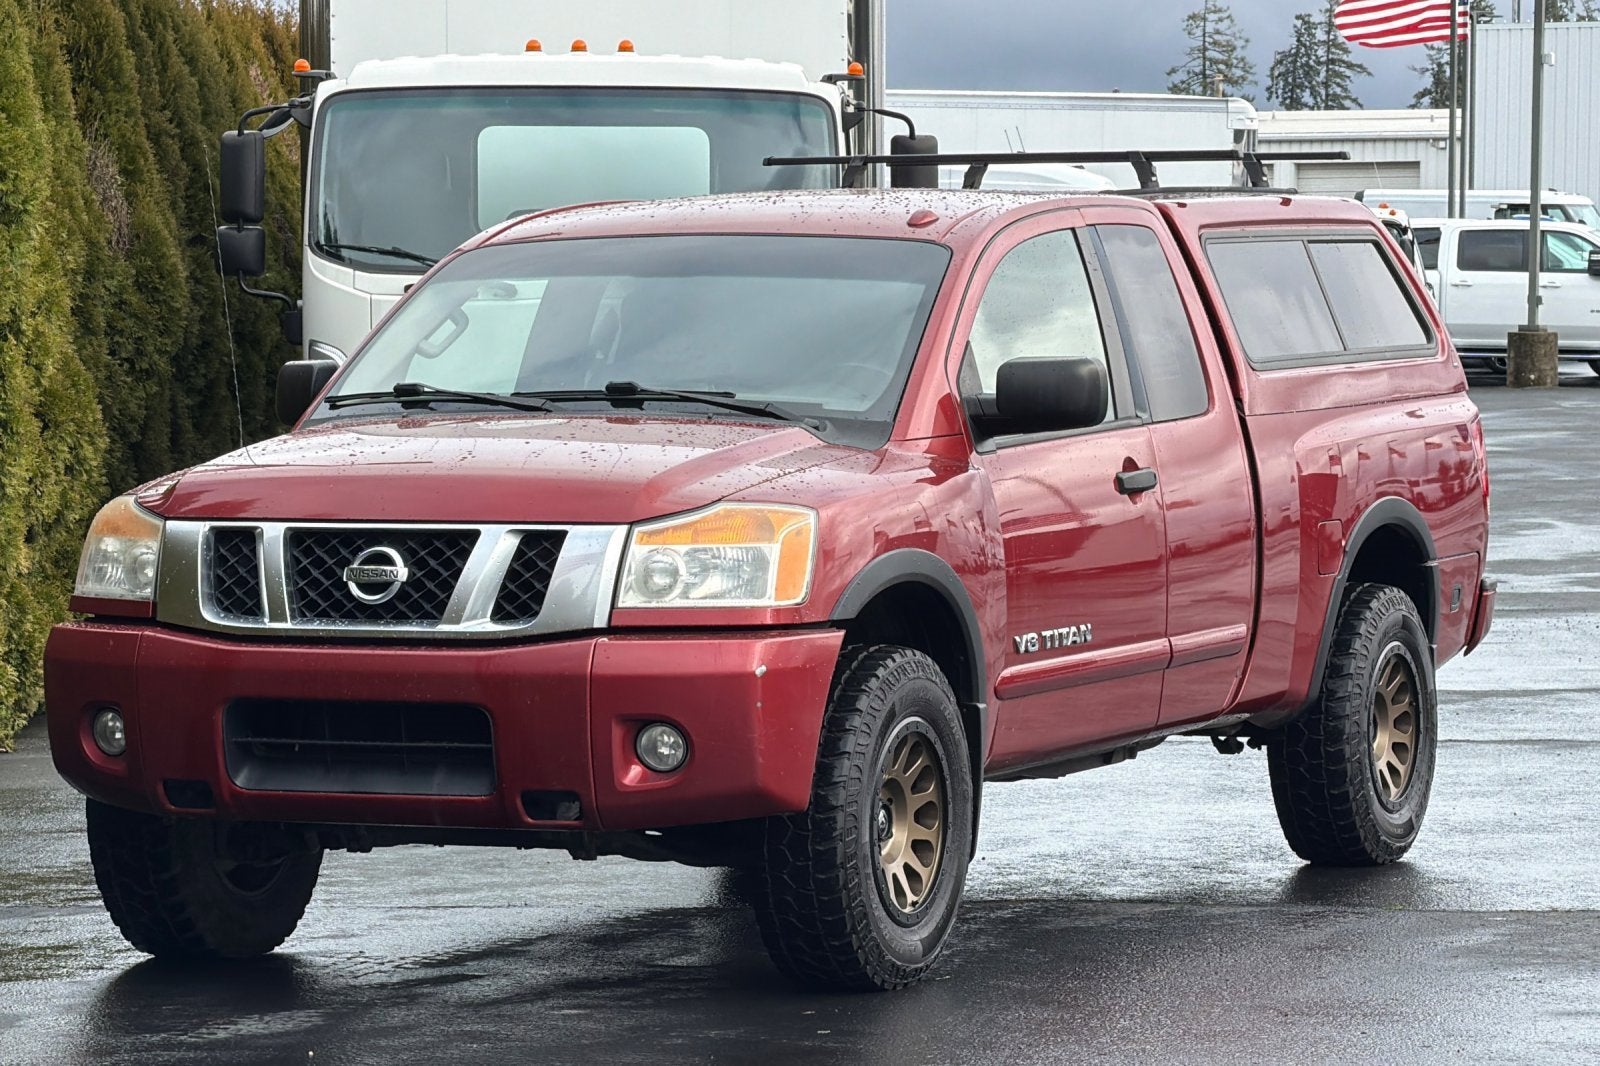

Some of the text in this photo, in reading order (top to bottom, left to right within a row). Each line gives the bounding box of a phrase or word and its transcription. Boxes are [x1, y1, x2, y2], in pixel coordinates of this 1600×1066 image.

[348, 569, 399, 579] NISSAN
[1013, 623, 1092, 654] V8 TITAN
